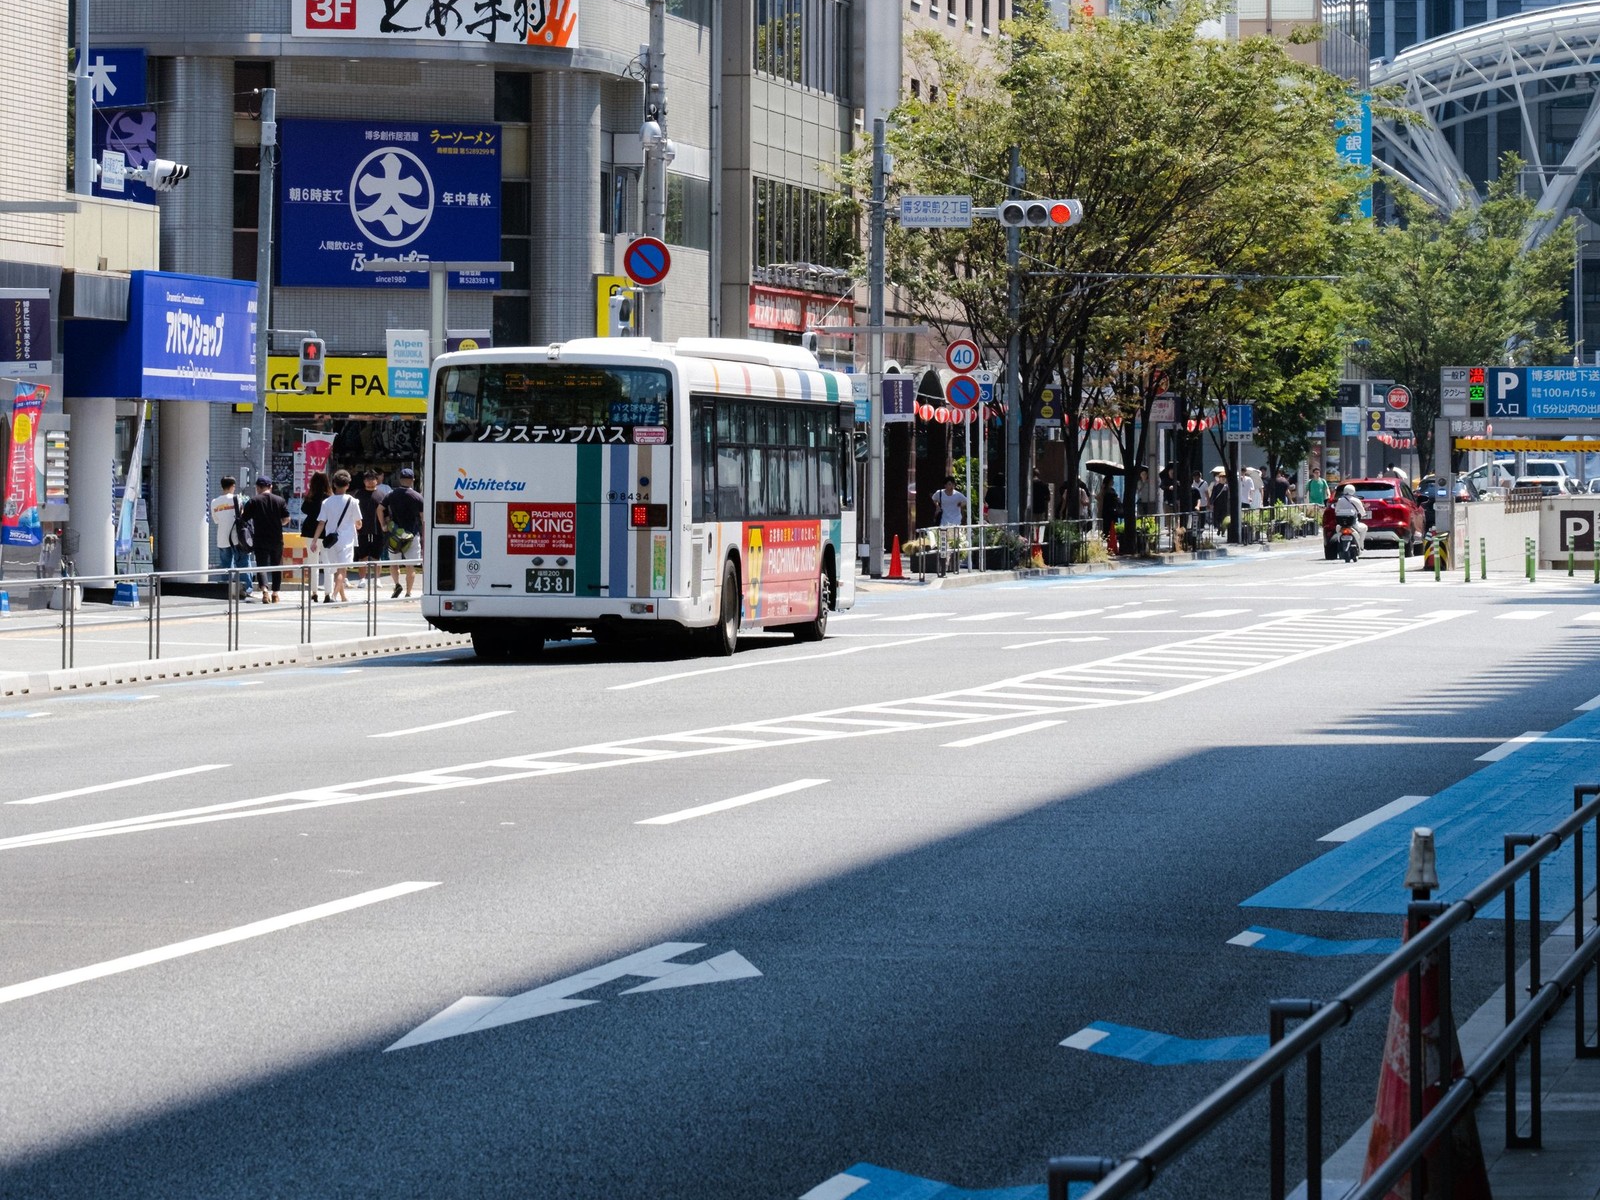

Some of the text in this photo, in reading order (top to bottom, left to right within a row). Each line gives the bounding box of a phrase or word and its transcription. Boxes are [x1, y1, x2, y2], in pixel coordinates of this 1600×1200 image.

[365, 130, 419, 142] 博多創作居酒屋
[429, 129, 496, 145] ラーソーメン
[289, 188, 344, 202] 朝6時まで
[442, 192, 492, 207] 年中無休
[903, 200, 969, 214] 博多駅前2丁目
[943, 215, 968, 223] 2-chome
[319, 241, 364, 251] 人間飲むとき
[375, 275, 407, 284] since1980
[166, 308, 225, 358] アパマンショップ
[394, 340, 423, 348] Alpen
[952, 348, 972, 366] 40
[394, 370, 423, 379] Alpen
[1497, 372, 1519, 399] P
[1444, 389, 1466, 397] タクシー
[1495, 402, 1519, 414] 入口
[1451, 420, 1484, 432] 博多駅
[477, 425, 626, 443] ノンステップバス
[454, 476, 526, 492] Nishitetsu
[620, 492, 649, 501] 8434
[531, 510, 574, 518] PACHINKO
[532, 519, 574, 533] KING
[1566, 517, 1590, 546] P
[468, 562, 479, 571] 60
[768, 545, 816, 574] PACHINKO KING
[534, 577, 570, 592] 43-81
